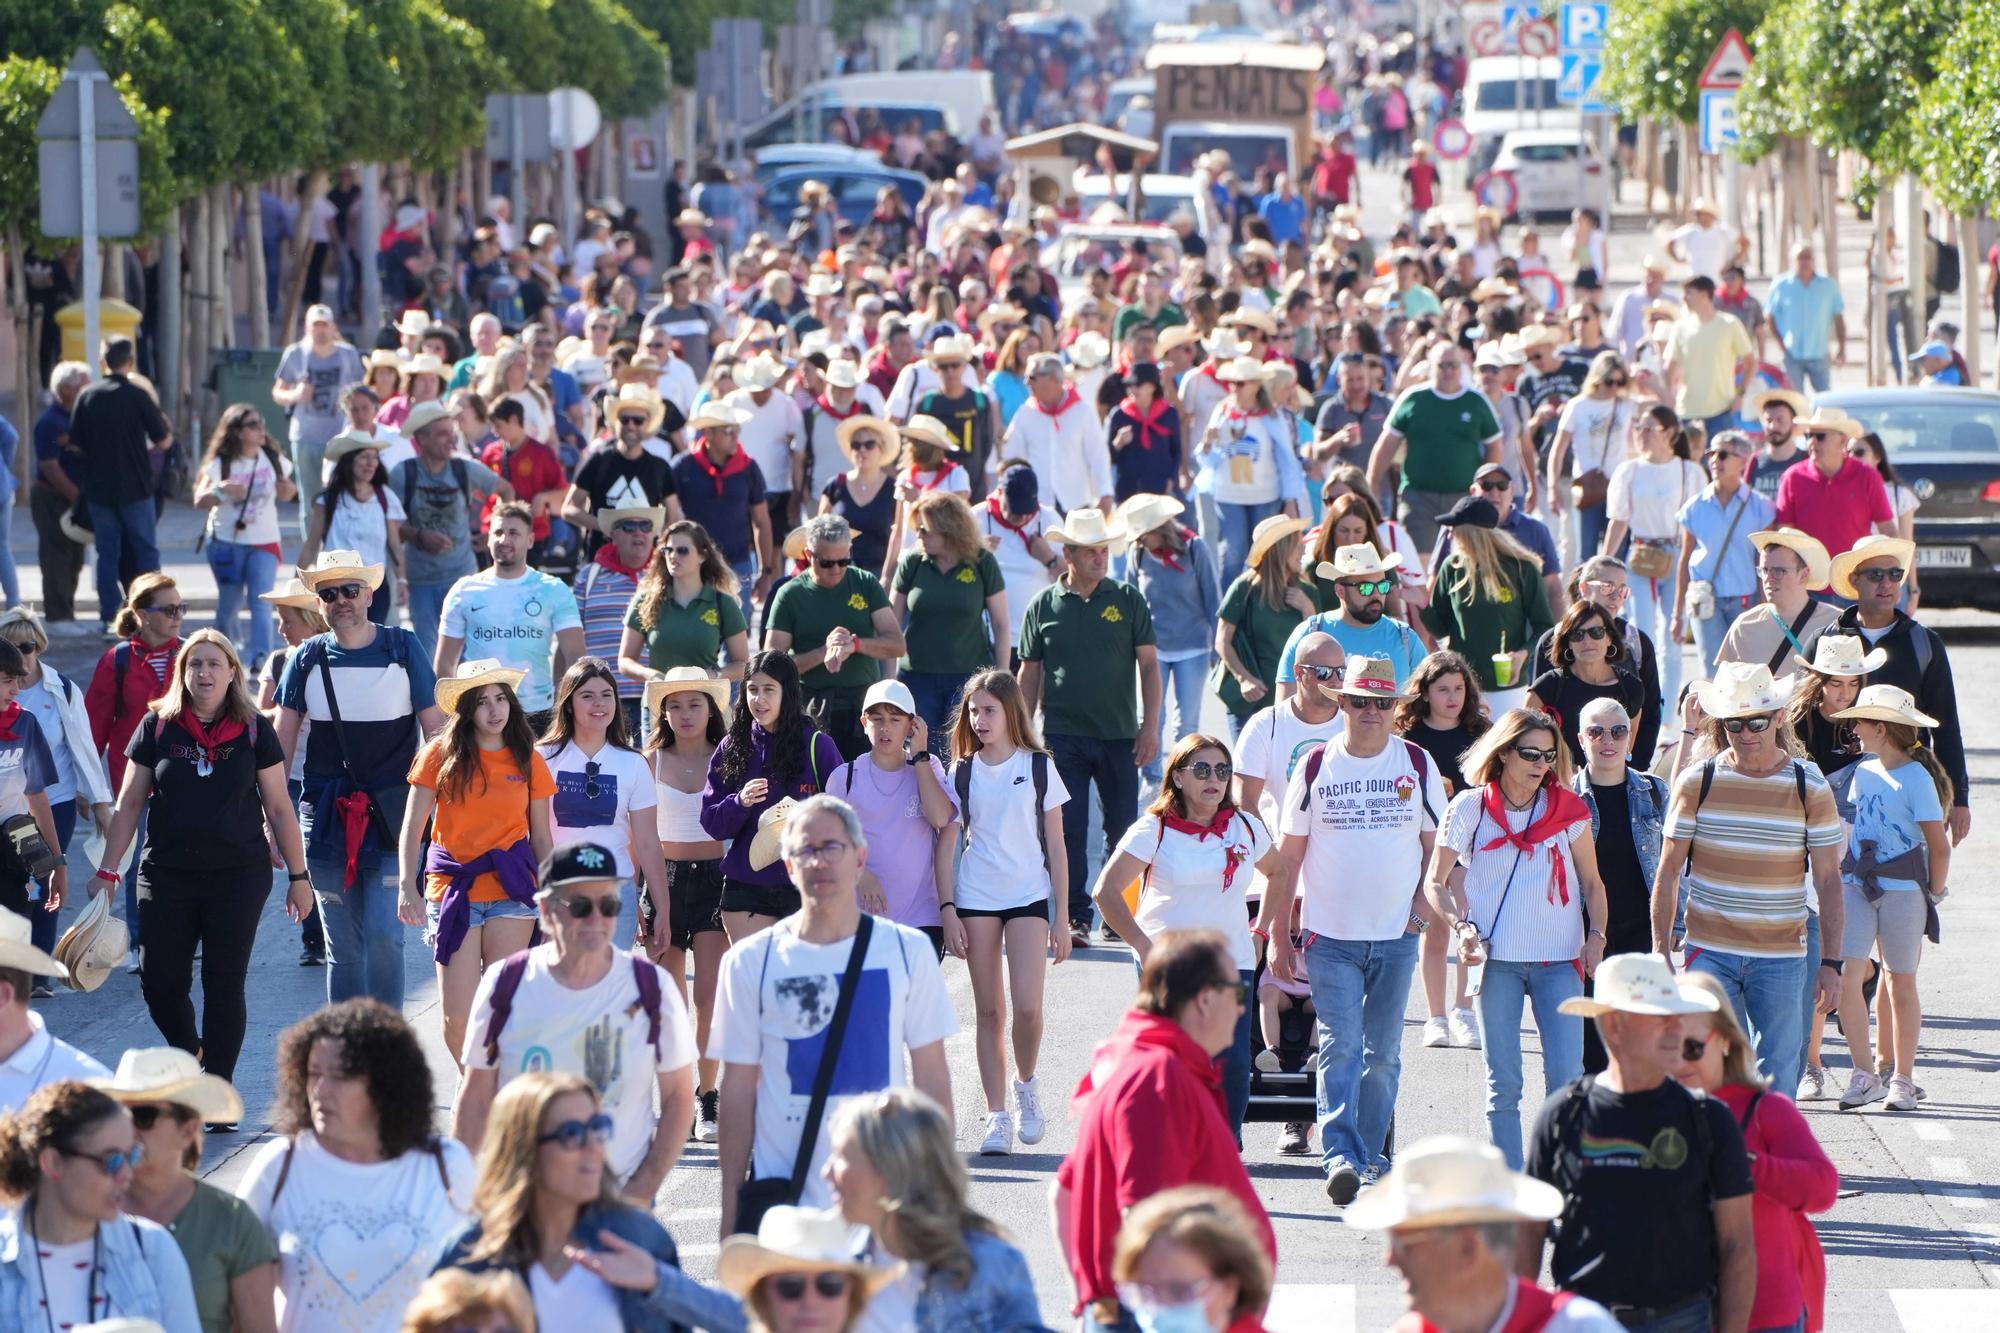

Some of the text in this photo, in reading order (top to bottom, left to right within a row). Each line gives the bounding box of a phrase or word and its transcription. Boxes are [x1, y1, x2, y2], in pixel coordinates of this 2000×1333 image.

[1569, 6, 1599, 46] P
[473, 626, 544, 642] digitalbits
[169, 745, 234, 760] DKY
[557, 786, 618, 796] ROOYN
[1318, 781, 1361, 799] PACIFIC
[1326, 798, 1408, 810] SAIL CREW
